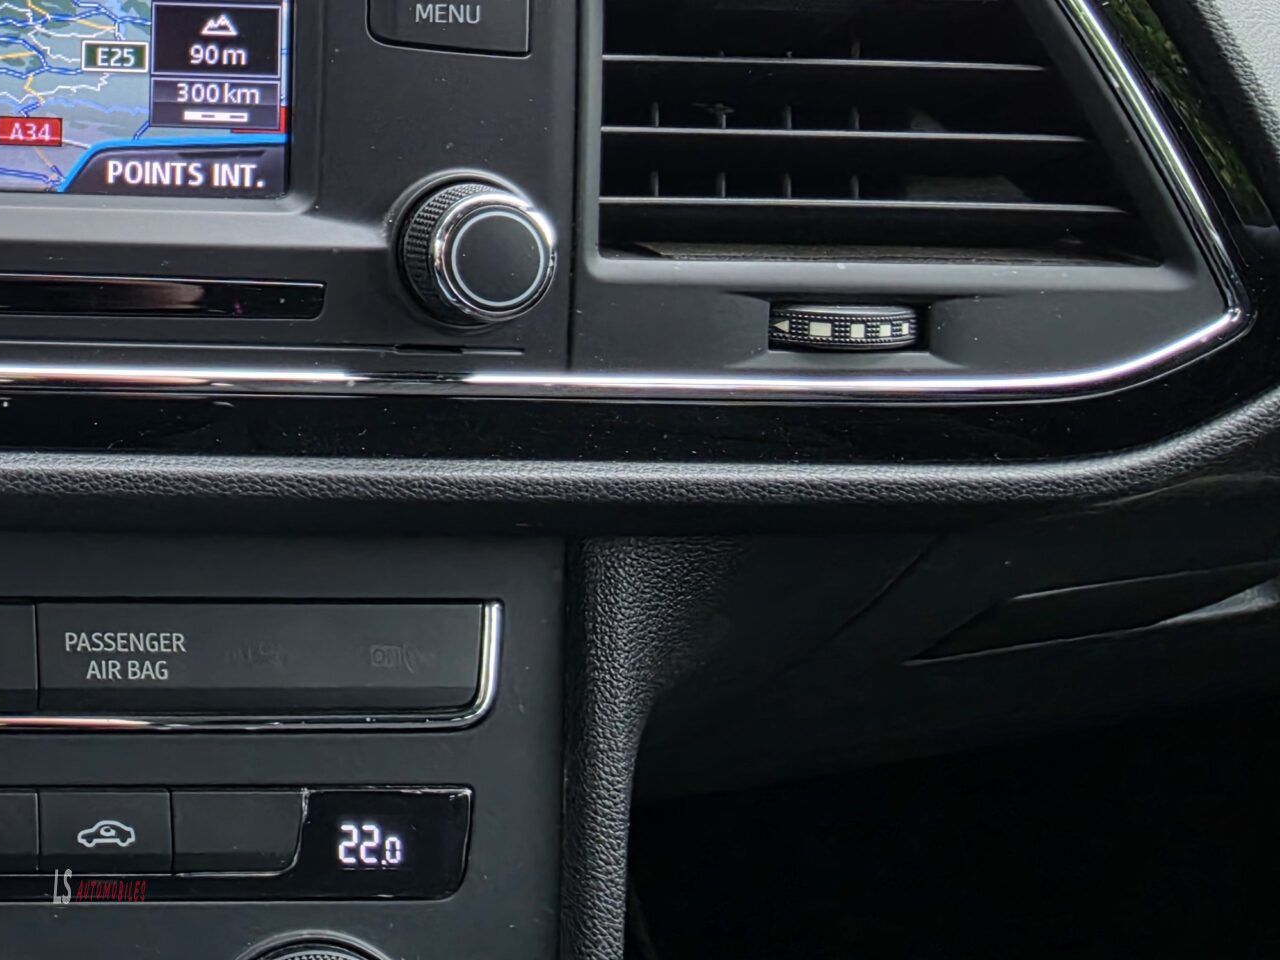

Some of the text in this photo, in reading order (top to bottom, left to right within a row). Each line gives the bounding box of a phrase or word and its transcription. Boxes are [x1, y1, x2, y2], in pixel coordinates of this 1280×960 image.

[414, 2, 482, 24] MENU
[97, 47, 136, 68] E25
[9, 121, 52, 141] A34
[107, 159, 266, 189] POINTS INT.
[64, 632, 187, 653] PASSENGER
[86, 660, 169, 681] AIR BAG
[337, 823, 404, 867] 22.0
